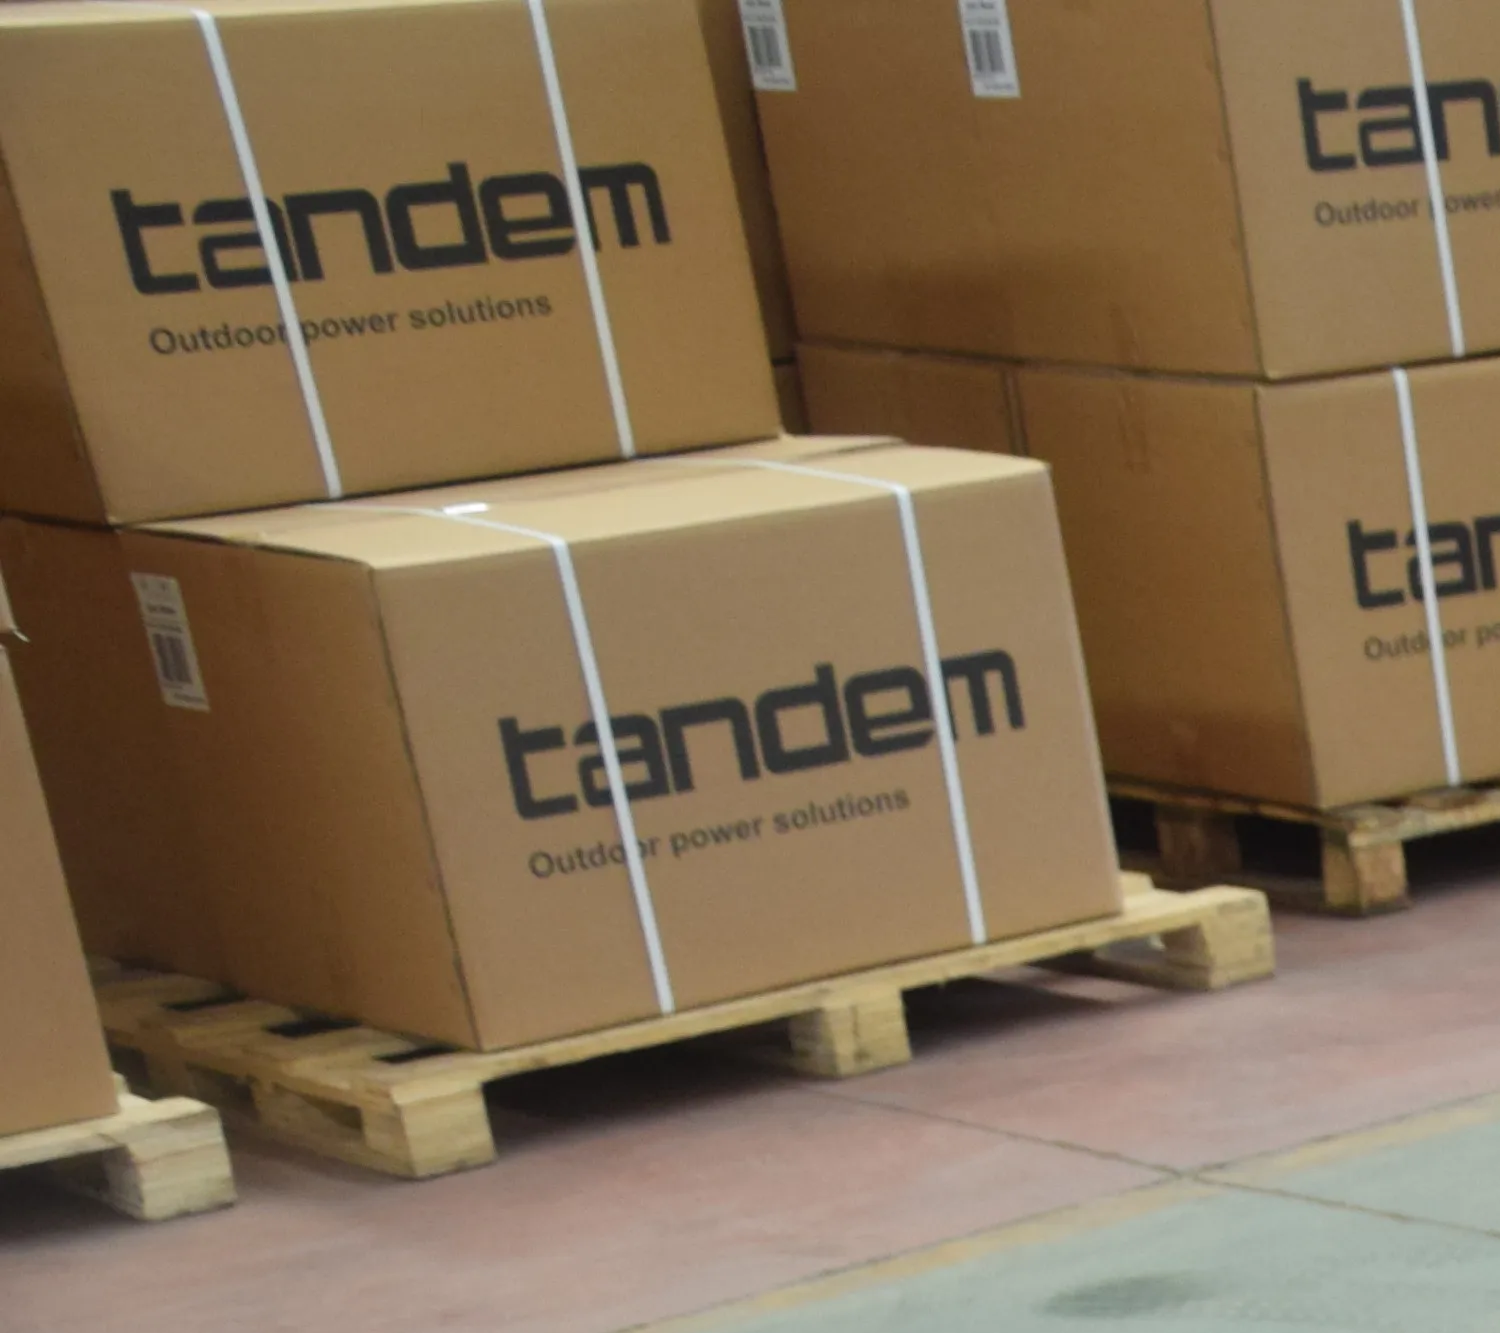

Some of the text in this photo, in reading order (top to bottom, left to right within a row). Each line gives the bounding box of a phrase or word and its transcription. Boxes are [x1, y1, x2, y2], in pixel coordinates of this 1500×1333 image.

[109, 162, 672, 296] tandem
[1314, 196, 1419, 227] Outdoor
[300, 310, 398, 347] power
[408, 294, 553, 331] solutions
[1363, 623, 1466, 660] Outdor
[498, 648, 1024, 822] tandem
[670, 815, 763, 858] power
[773, 788, 910, 834] solutions
